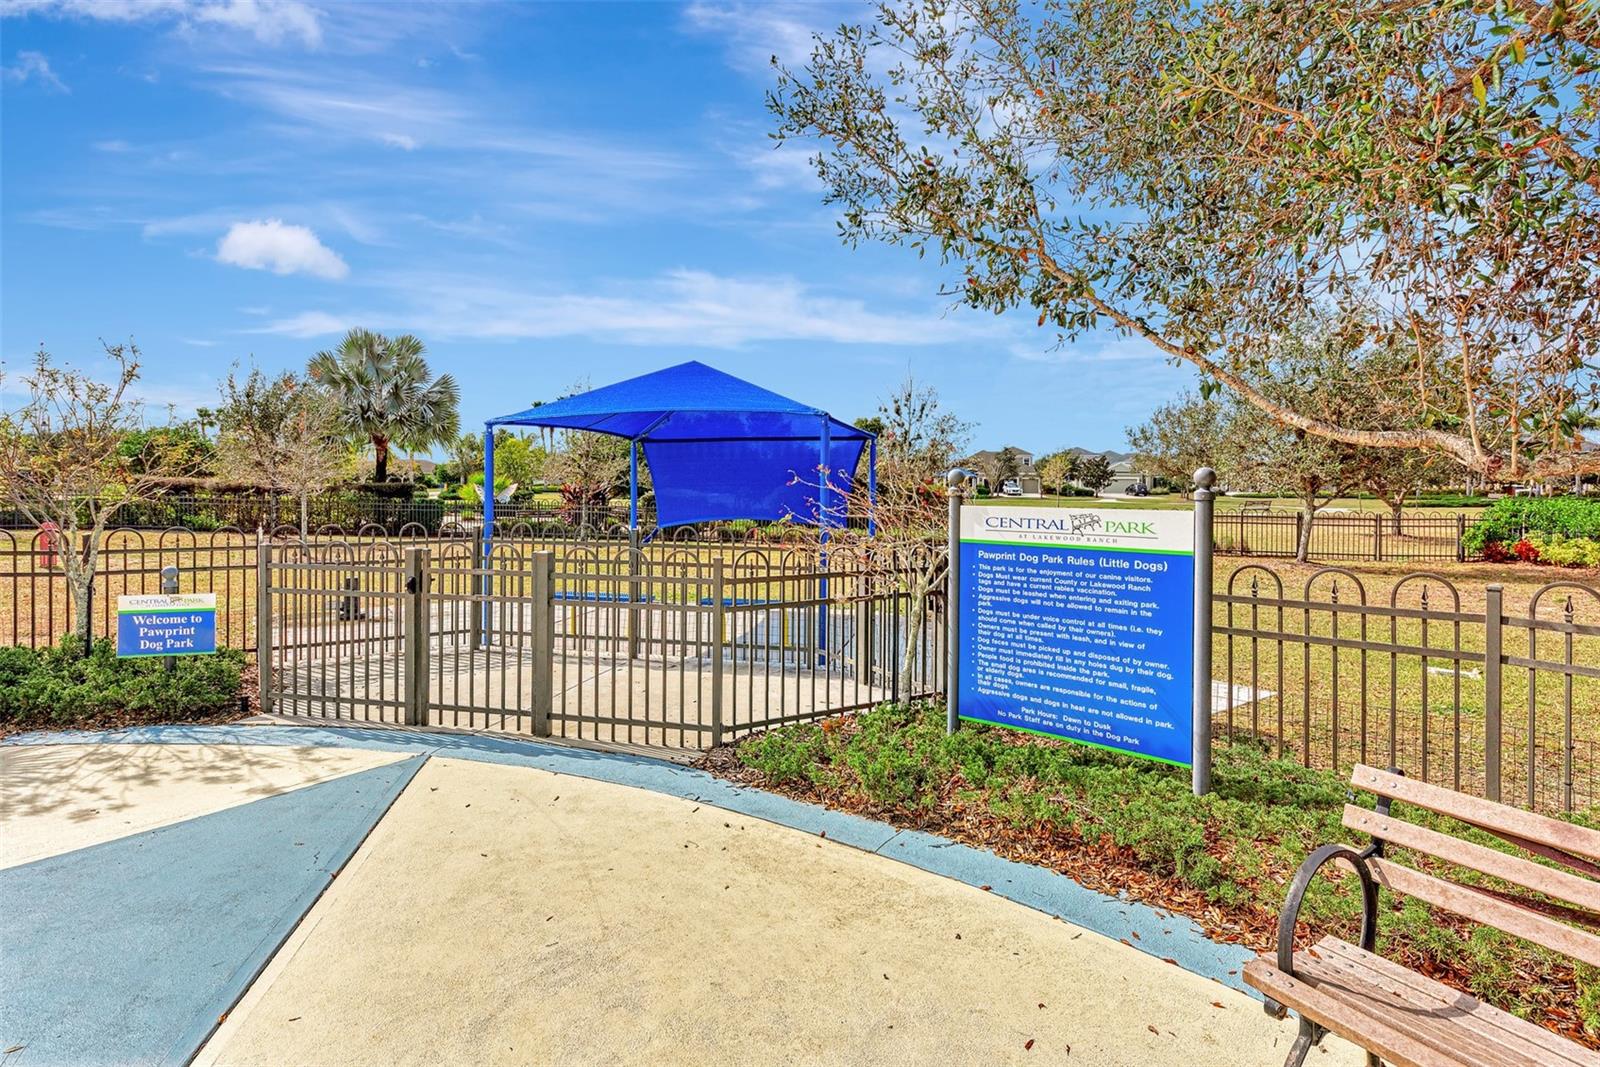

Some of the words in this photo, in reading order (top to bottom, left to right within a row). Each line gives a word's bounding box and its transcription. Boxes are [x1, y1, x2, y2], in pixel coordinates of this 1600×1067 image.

[985, 516, 1069, 531] CENTRAL
[1105, 521, 1158, 535] PARK
[1032, 534, 1086, 542] LAKEWOOD
[978, 550, 1016, 561] Pawprint
[1019, 552, 1039, 564] Dog
[1042, 554, 1063, 564] Park
[1067, 555, 1095, 566] Rules
[1099, 557, 1130, 568] (Little
[1134, 559, 1168, 572] Dogs)
[978, 571, 994, 579] Dogs
[1054, 577, 1078, 586] County
[1089, 580, 1126, 589] Lakewood
[1127, 583, 1151, 592] Ranch
[1039, 568, 1073, 576] enjoyment
[1124, 574, 1153, 583] visitors.
[978, 578, 992, 586] tags
[1077, 587, 1118, 596] vaccination.
[978, 585, 994, 593] Dogs
[1022, 589, 1048, 598] leashed
[1049, 592, 1067, 600] when
[1068, 594, 1097, 604] entering
[1114, 599, 1138, 608] exiting
[1140, 601, 1160, 609] park.
[978, 593, 1011, 602] Aggressive
[1013, 597, 1029, 605] dogs
[1066, 602, 1093, 611] allowed
[1104, 607, 1129, 615] remain
[1139, 609, 1152, 617] the
[132, 615, 188, 625] Welcome
[191, 614, 202, 624] to
[977, 607, 994, 615] Dogs
[1042, 615, 1060, 623] voice
[1062, 618, 1086, 626] control
[1107, 622, 1128, 631] times
[1130, 624, 1144, 632] (i.e.
[1146, 626, 1163, 636] they
[1058, 624, 1067, 632] by
[1068, 625, 1084, 633] their
[1086, 628, 1116, 637] owners).
[140, 626, 196, 638] Pawprint
[977, 622, 1000, 630] Owners
[1029, 629, 1054, 637] present
[1072, 634, 1092, 643] leash,
[1118, 640, 1135, 648] view
[993, 630, 1005, 638] dog
[1024, 634, 1044, 643] times.
[140, 640, 164, 651] Dog
[166, 638, 194, 648] Park
[977, 636, 990, 644] Dog
[991, 638, 1009, 646] feces
[1038, 645, 1061, 653] picked
[1087, 651, 1120, 662] disposed
[1144, 660, 1170, 669] owner.
[977, 644, 997, 652] Owner
[1015, 649, 1053, 662] immediately
[1074, 658, 1086, 667] any
[1088, 660, 1107, 669] holes
[1109, 663, 1123, 672] dug
[1137, 667, 1154, 676] their
[1156, 670, 1174, 680] dog.
[977, 651, 998, 660] People
[999, 655, 1014, 663] food
[1023, 659, 1056, 669] prohibited
[1057, 663, 1077, 672] inside
[1092, 670, 1110, 678] park.
[985, 667, 1005, 676] elderly
[1006, 670, 1025, 679] dogs.
[977, 659, 989, 667] The
[1008, 664, 1021, 673] dog
[1046, 671, 1094, 684] recommended
[1095, 678, 1106, 686] for
[1108, 681, 1129, 690] small,
[1131, 683, 1156, 694] fragile,
[977, 678, 991, 686] their
[992, 681, 1010, 690] dogs.
[993, 676, 1013, 685] cases,
[1015, 680, 1038, 688] owners
[1052, 686, 1091, 698] responsible
[1093, 692, 1103, 700] for
[1105, 694, 1118, 702] the
[1120, 697, 1147, 708] actions
[977, 686, 1011, 698] Aggressive
[1012, 692, 1028, 701] dogs
[1043, 698, 1060, 707] dogs
[1070, 703, 1085, 712] heat
[1101, 709, 1113, 717] not
[1115, 712, 1144, 722] allowed
[1155, 719, 1174, 728] park.
[1021, 706, 1035, 715] Park
[1037, 710, 1058, 720] Hours:
[1062, 714, 1082, 724] Dawn
[1093, 720, 1111, 730] Dusk
[1008, 712, 1022, 720] Park
[1024, 715, 1041, 724] Staff
[1042, 719, 1053, 727] are
[1066, 723, 1081, 733] duty
[1092, 728, 1104, 737] the
[1106, 731, 1121, 742] Dog
[1123, 734, 1139, 744] Park
